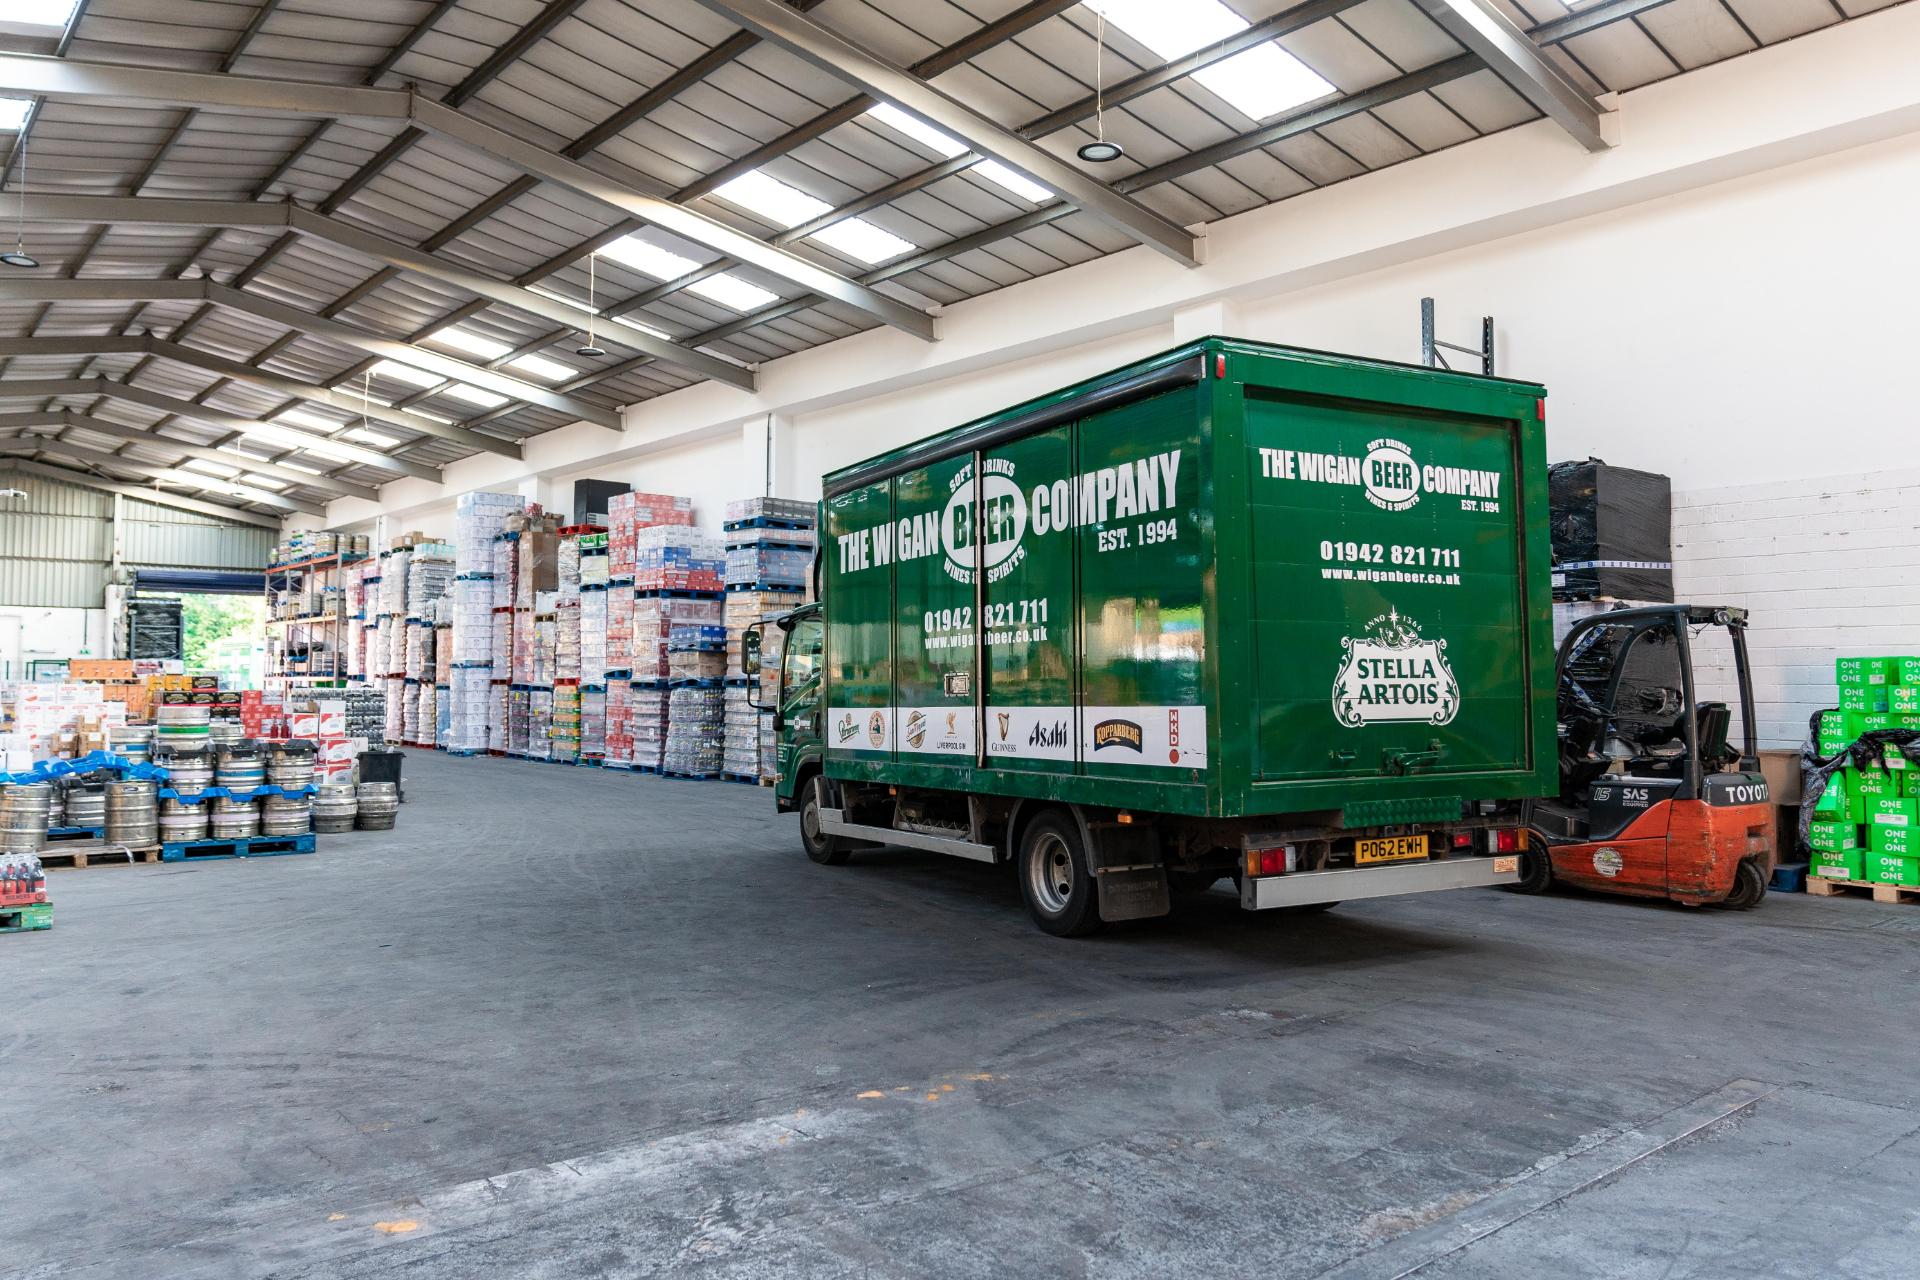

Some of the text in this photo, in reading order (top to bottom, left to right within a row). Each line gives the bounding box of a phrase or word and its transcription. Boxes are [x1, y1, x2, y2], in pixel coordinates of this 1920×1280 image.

[1366, 438, 1412, 455] SOFT DRINKS
[950, 463, 972, 493] SOFT
[1259, 448, 1500, 498] THE WIGAN BEER COMPANY
[1364, 490, 1386, 509] WINES
[1394, 494, 1420, 511] SPIRITS
[1461, 500, 1500, 513] EST. 1994
[838, 529, 870, 574] THE
[872, 510, 939, 567] WIGAN
[1032, 450, 1181, 536] COMPANY
[1098, 518, 1177, 552] EST. 1994
[1320, 540, 1460, 568] 01942 821 711
[944, 558, 970, 584] WINES
[988, 545, 1024, 583] SPIRITS
[1322, 568, 1460, 585] www.wiganbeer.co.uk
[924, 598, 1048, 632] 01942 821 711
[1364, 614, 1422, 632] ANNO 1366
[1358, 658, 1436, 679] STELLA
[1841, 674, 1860, 682] ONE
[1906, 674, 1920, 682] ON
[1358, 684, 1438, 704] ARTOIS
[1844, 688, 1864, 696] ONE
[1894, 688, 1917, 696] ONE
[1844, 702, 1864, 710] ONE
[1894, 702, 1918, 710] ONE
[1864, 716, 1886, 724] ONE
[1170, 710, 1178, 744] WKD
[1822, 728, 1842, 736] ONE
[1028, 720, 1068, 748] Asahi
[1096, 724, 1140, 744] KOPPARBERG
[992, 742, 1016, 752] GUINNESS
[1824, 742, 1846, 750] ONE
[1884, 744, 1900, 752] NE
[1860, 772, 1882, 780] ONE
[1622, 788, 1648, 800] SAS
[1725, 784, 1768, 802] TOYOTA
[1860, 786, 1882, 794] ONE
[1880, 800, 1902, 808] ONE
[1813, 825, 1834, 833] ONE
[1885, 830, 1906, 838] ONE
[1814, 838, 1834, 847] ONE
[1361, 838, 1422, 859] PO62 EWH
[1885, 844, 1906, 852] ONE
[1822, 852, 1844, 861] ONE
[1880, 858, 1903, 866] ONE
[1881, 872, 1904, 880] ONE
